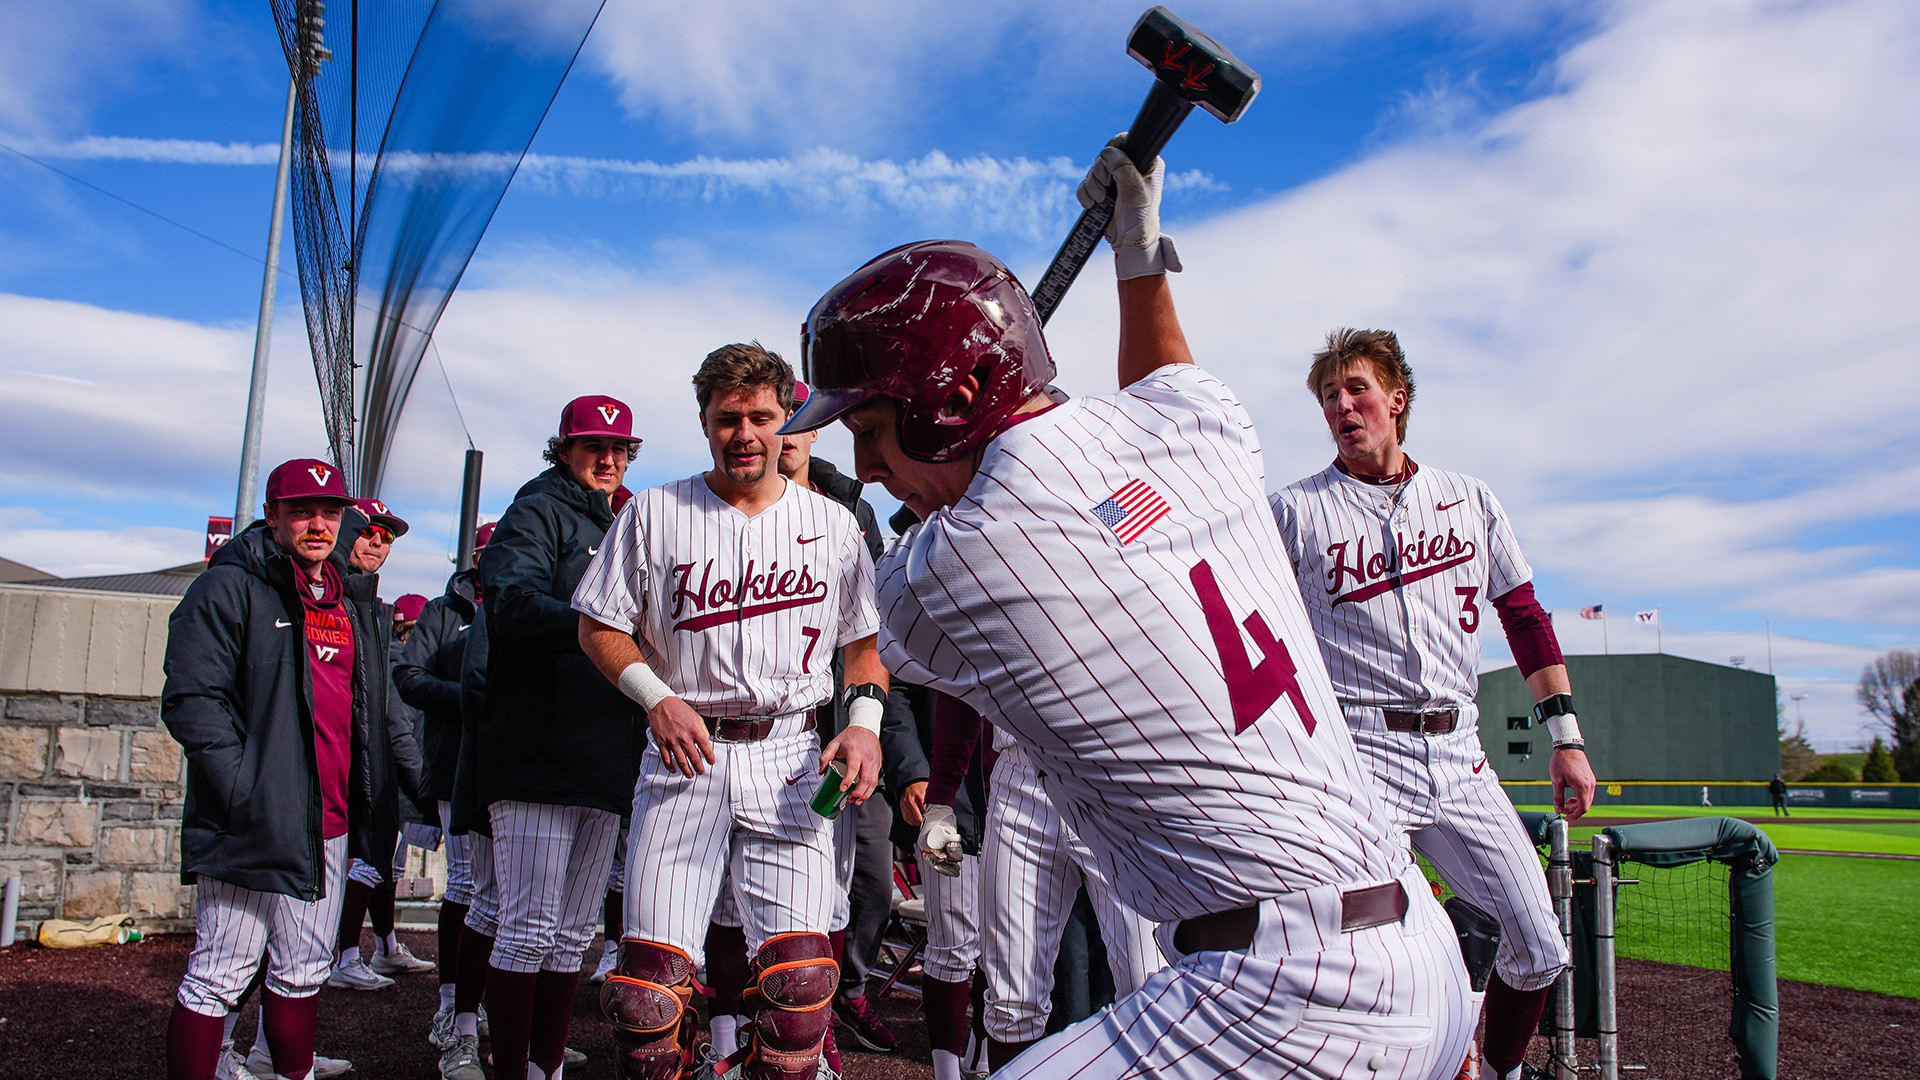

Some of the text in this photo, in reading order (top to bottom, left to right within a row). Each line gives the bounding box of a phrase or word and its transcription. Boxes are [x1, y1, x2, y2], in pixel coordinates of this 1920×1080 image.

[208, 533, 230, 546] VT
[1326, 527, 1475, 609] Hokies
[305, 611, 336, 628] INIA
[671, 558, 828, 633] Hokies
[1455, 586, 1479, 634] 3
[315, 644, 339, 662] VT
[802, 626, 821, 674] 7
[1189, 558, 1317, 738] 4
[1607, 785, 1622, 796] 400
